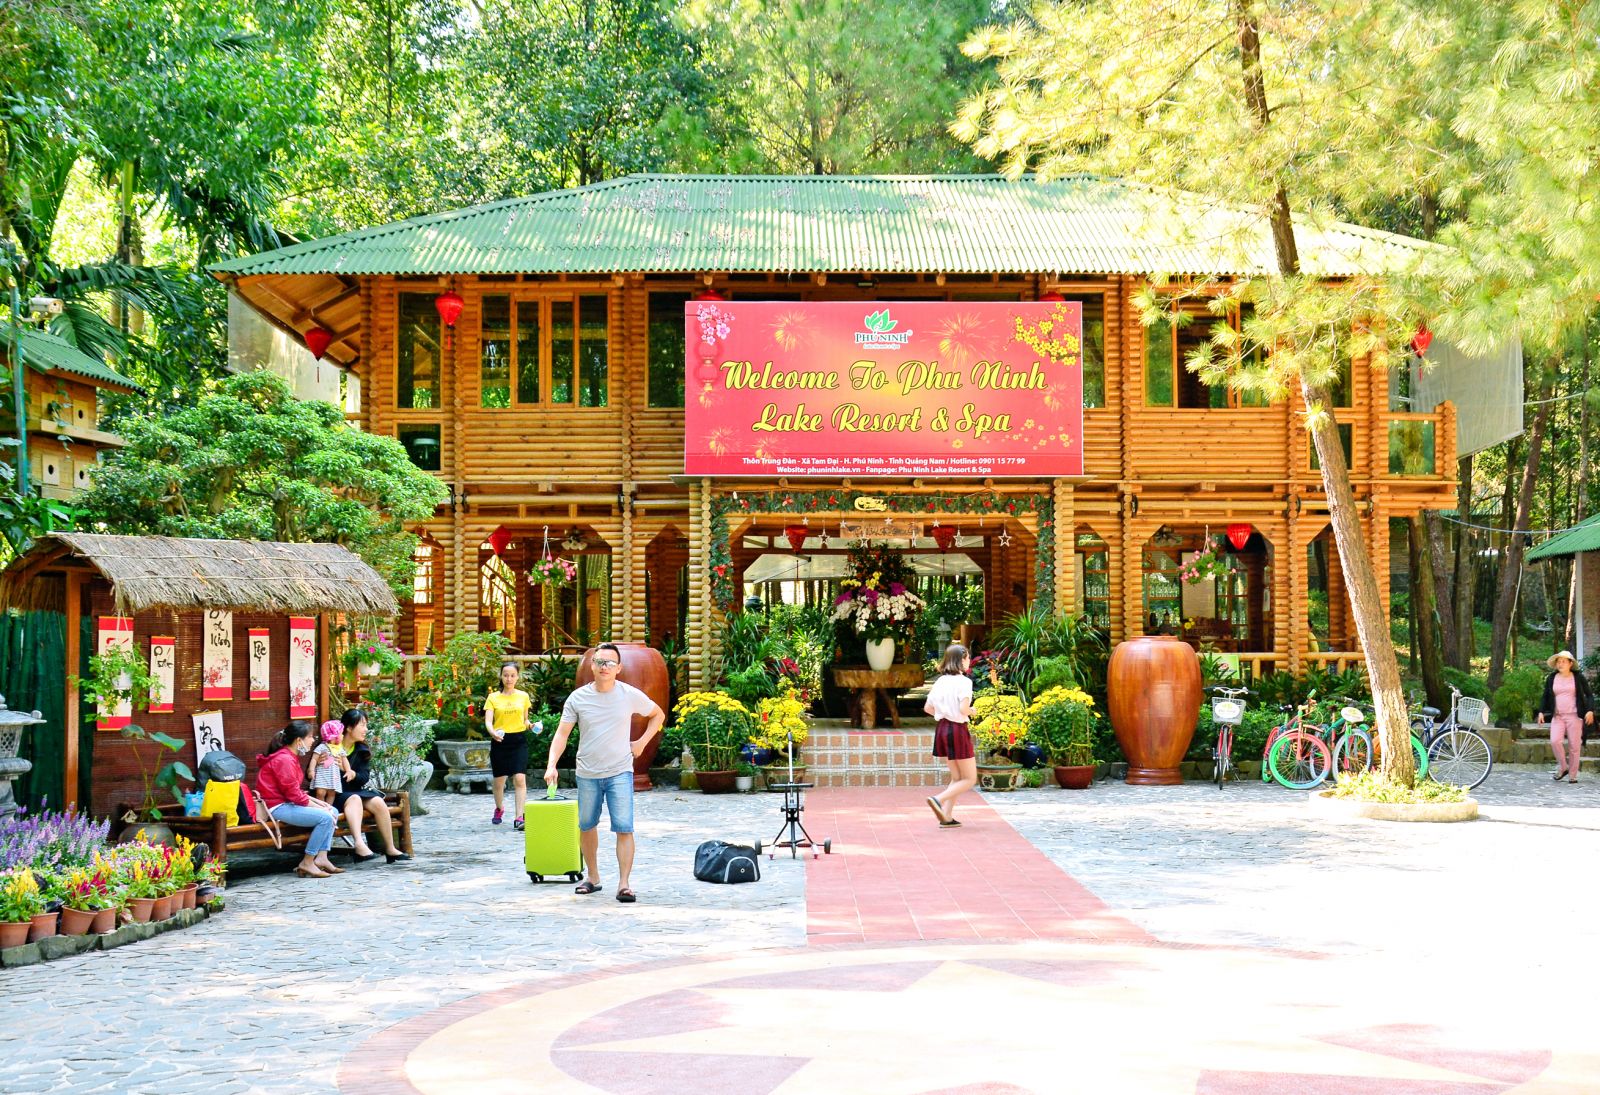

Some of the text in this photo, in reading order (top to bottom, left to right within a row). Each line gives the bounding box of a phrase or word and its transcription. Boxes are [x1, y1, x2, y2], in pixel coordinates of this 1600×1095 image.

[880, 333, 907, 342] NINH
[720, 360, 1048, 396] Welcome To Phu Ninh
[751, 403, 1013, 439] Lake Resort & Spa
[761, 457, 781, 465] Trung
[827, 457, 839, 465] Đại
[807, 466, 861, 474] phuninhlake.vn
[866, 466, 898, 474] Fanpage:
[979, 466, 992, 474] Spa
